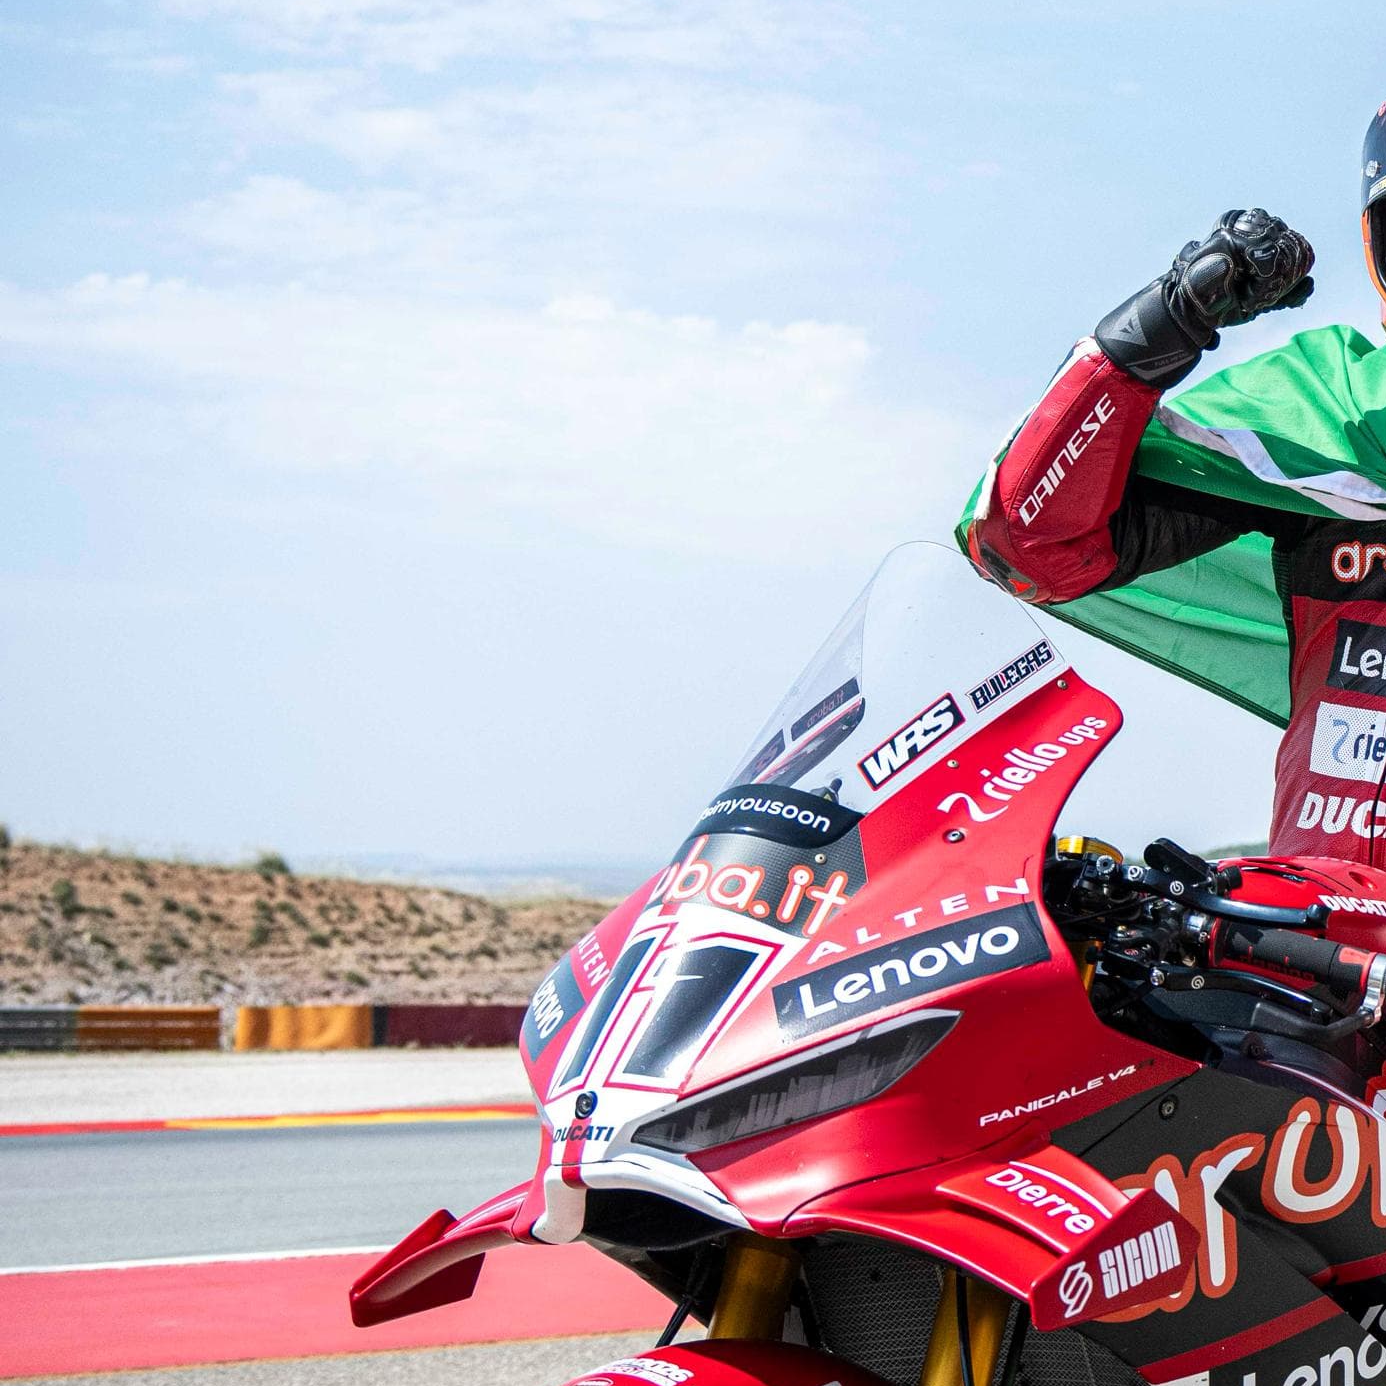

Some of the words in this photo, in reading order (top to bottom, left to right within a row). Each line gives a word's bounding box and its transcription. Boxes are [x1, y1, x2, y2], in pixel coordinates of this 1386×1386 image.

[1017, 392, 1117, 527] DAINESE
[863, 698, 956, 785] WRS
[980, 747, 1068, 802] riello
[1057, 716, 1108, 746] ups
[806, 877, 1031, 965] ALTEN
[799, 925, 1020, 1020] Lenovo
[552, 1125, 614, 1143] DUCATI
[979, 1066, 1105, 1127] PANIGALE
[1098, 1220, 1182, 1300] SICOM
